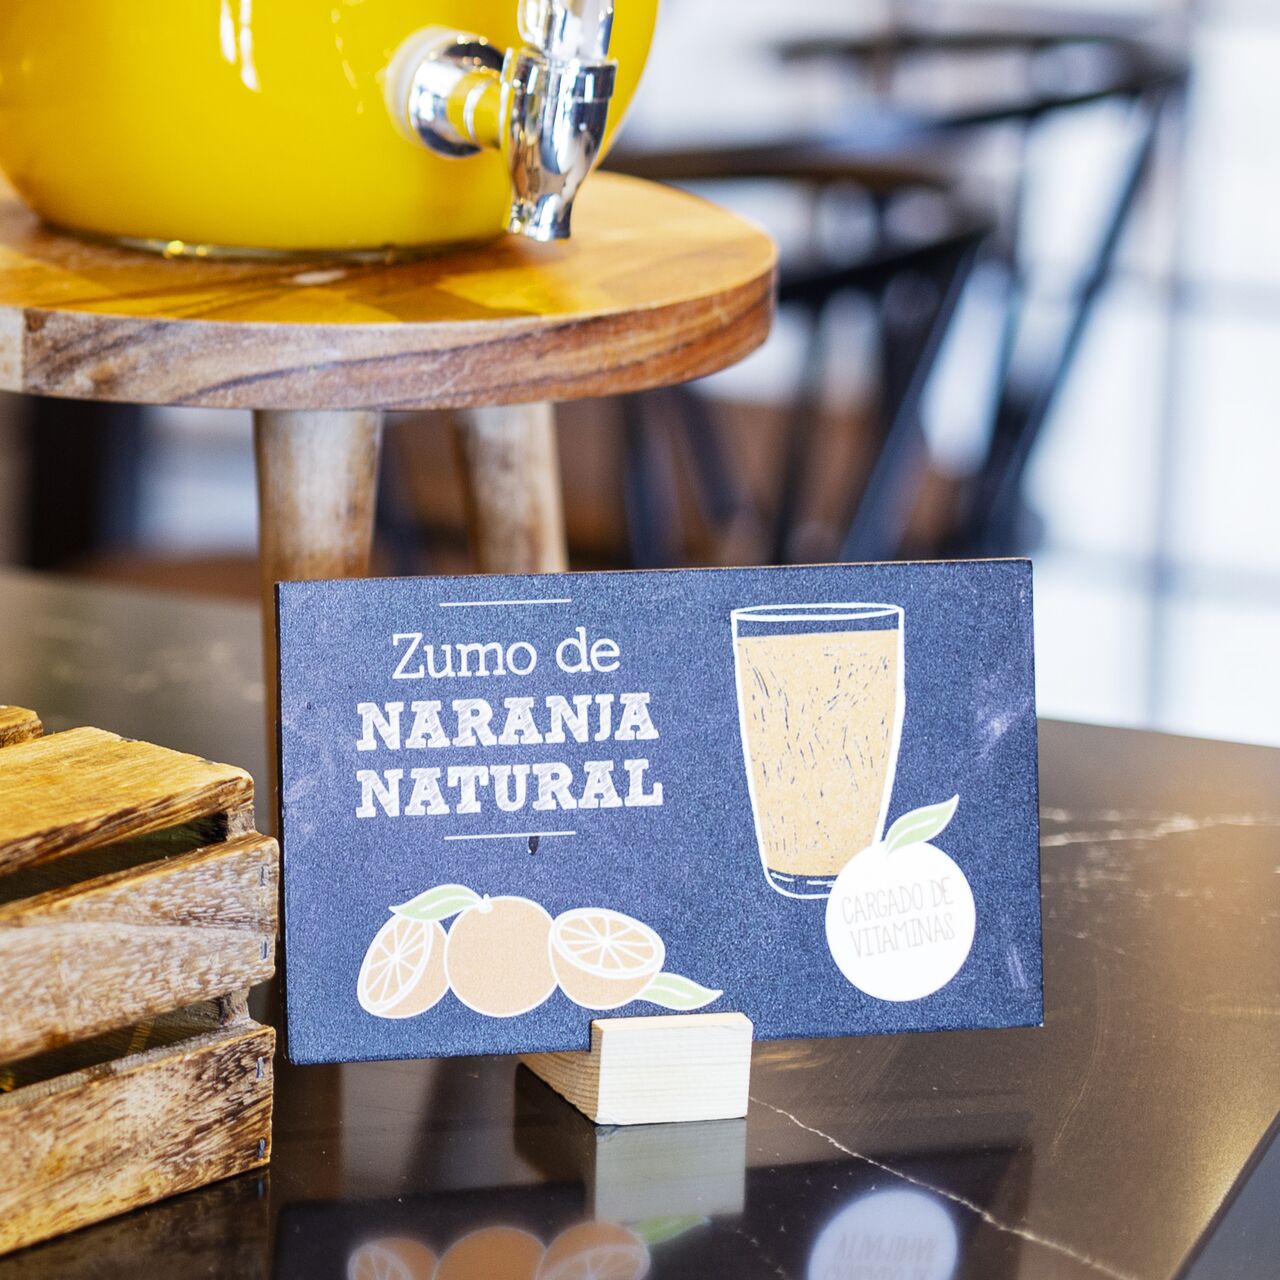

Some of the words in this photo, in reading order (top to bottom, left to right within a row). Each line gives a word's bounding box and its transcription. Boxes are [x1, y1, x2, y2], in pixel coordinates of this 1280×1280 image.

[392, 632, 537, 680] Zumo
[556, 626, 621, 673] de
[356, 692, 659, 751] NARANJA
[356, 758, 663, 818] NATURAL
[841, 882, 924, 925] CARGADO
[930, 876, 954, 908] DE
[849, 912, 956, 958] VITAMINAS
